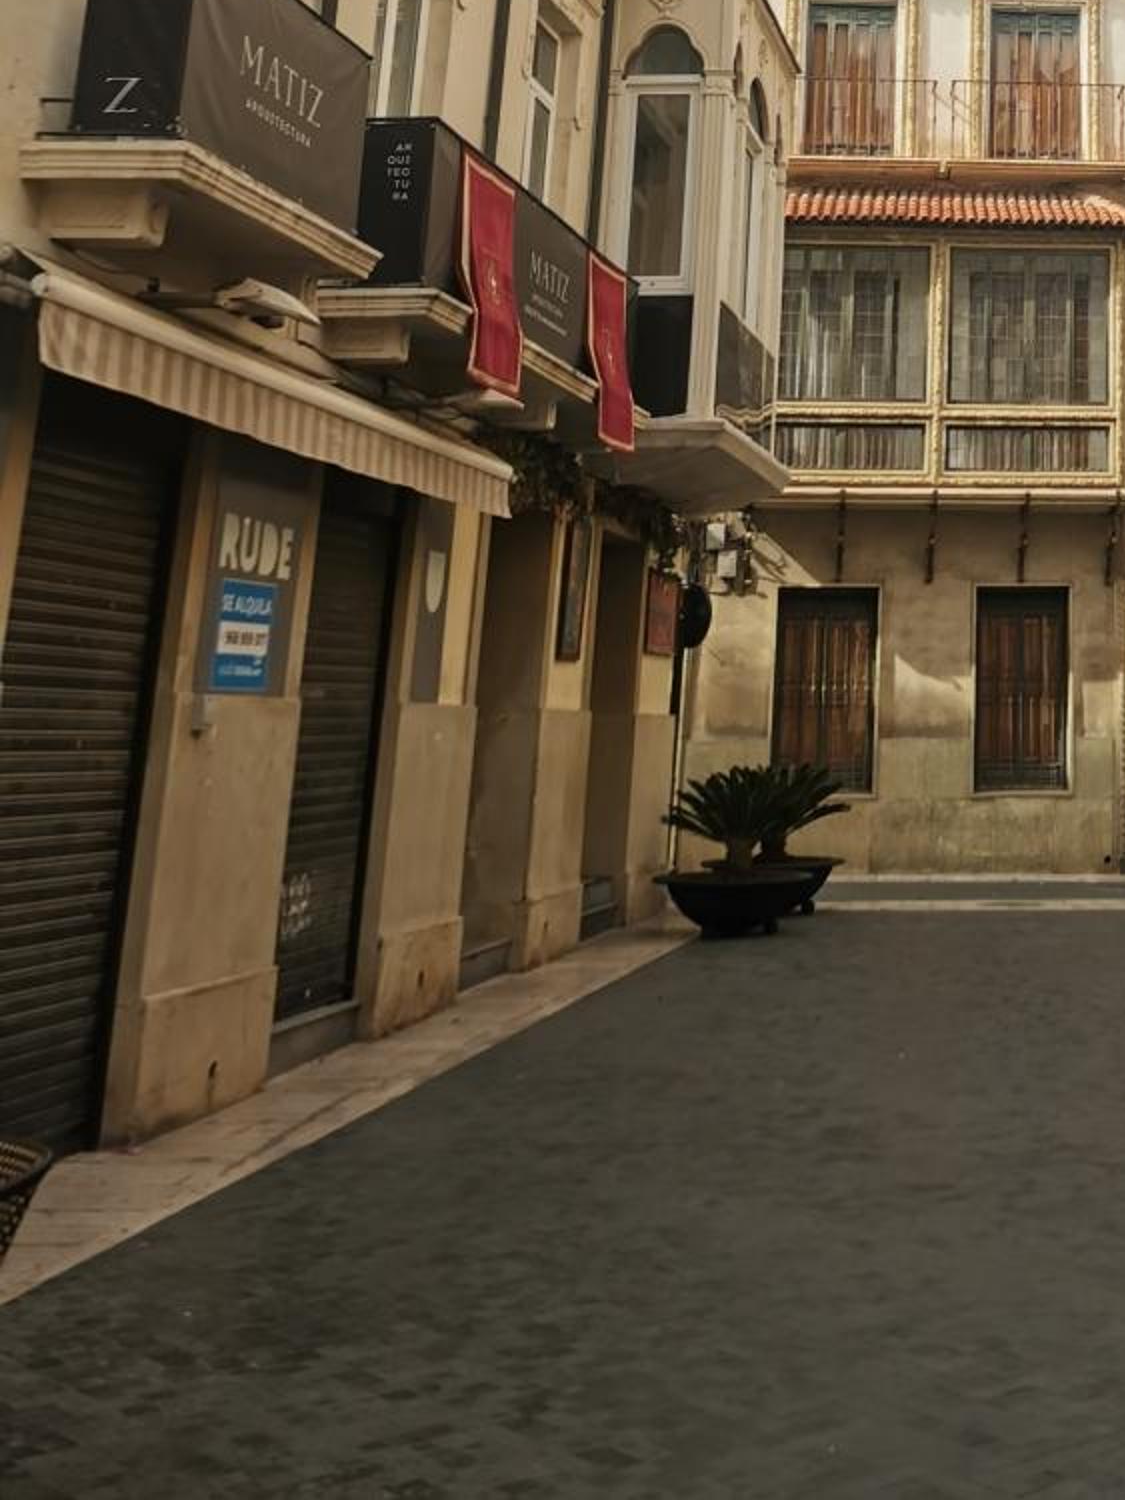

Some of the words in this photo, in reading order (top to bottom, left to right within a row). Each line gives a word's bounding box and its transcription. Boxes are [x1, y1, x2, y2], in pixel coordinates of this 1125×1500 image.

[103, 77, 141, 113] Z
[240, 35, 324, 128] MATIZ
[394, 179, 410, 189] TU
[528, 250, 570, 303] MATIZ
[218, 512, 294, 581] RUDE
